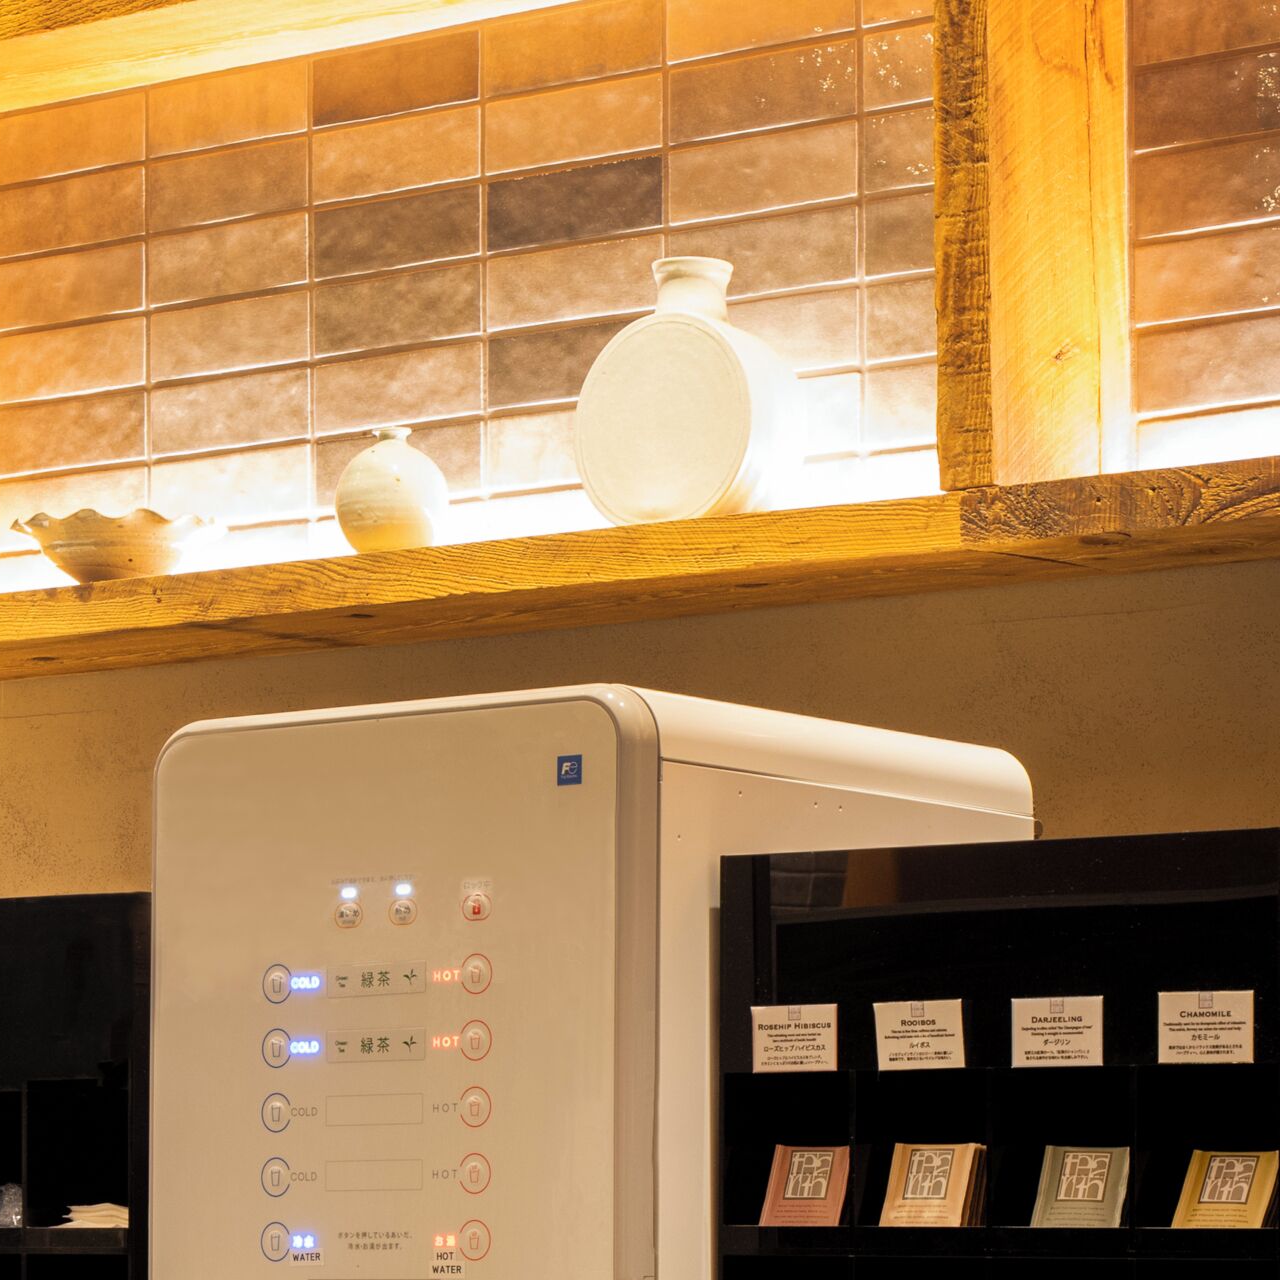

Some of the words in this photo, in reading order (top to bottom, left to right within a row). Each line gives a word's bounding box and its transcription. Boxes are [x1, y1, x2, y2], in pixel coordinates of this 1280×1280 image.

[360, 971, 390, 988] 緑茶
[433, 970, 461, 982] HOT
[291, 976, 320, 989] COLD
[758, 1023, 792, 1031] ROSEHIP
[901, 1019, 936, 1027] ROOIBOS
[360, 1037, 390, 1054] 緑茶
[432, 1036, 460, 1047] HOT
[290, 1041, 320, 1054] COLD
[291, 1107, 318, 1117] COLD
[432, 1103, 458, 1113] HOT
[290, 1172, 317, 1182] COLD
[432, 1170, 458, 1180] HOT
[292, 1252, 320, 1261] WATER
[436, 1252, 455, 1260] HOT
[432, 1265, 462, 1274] WATER
